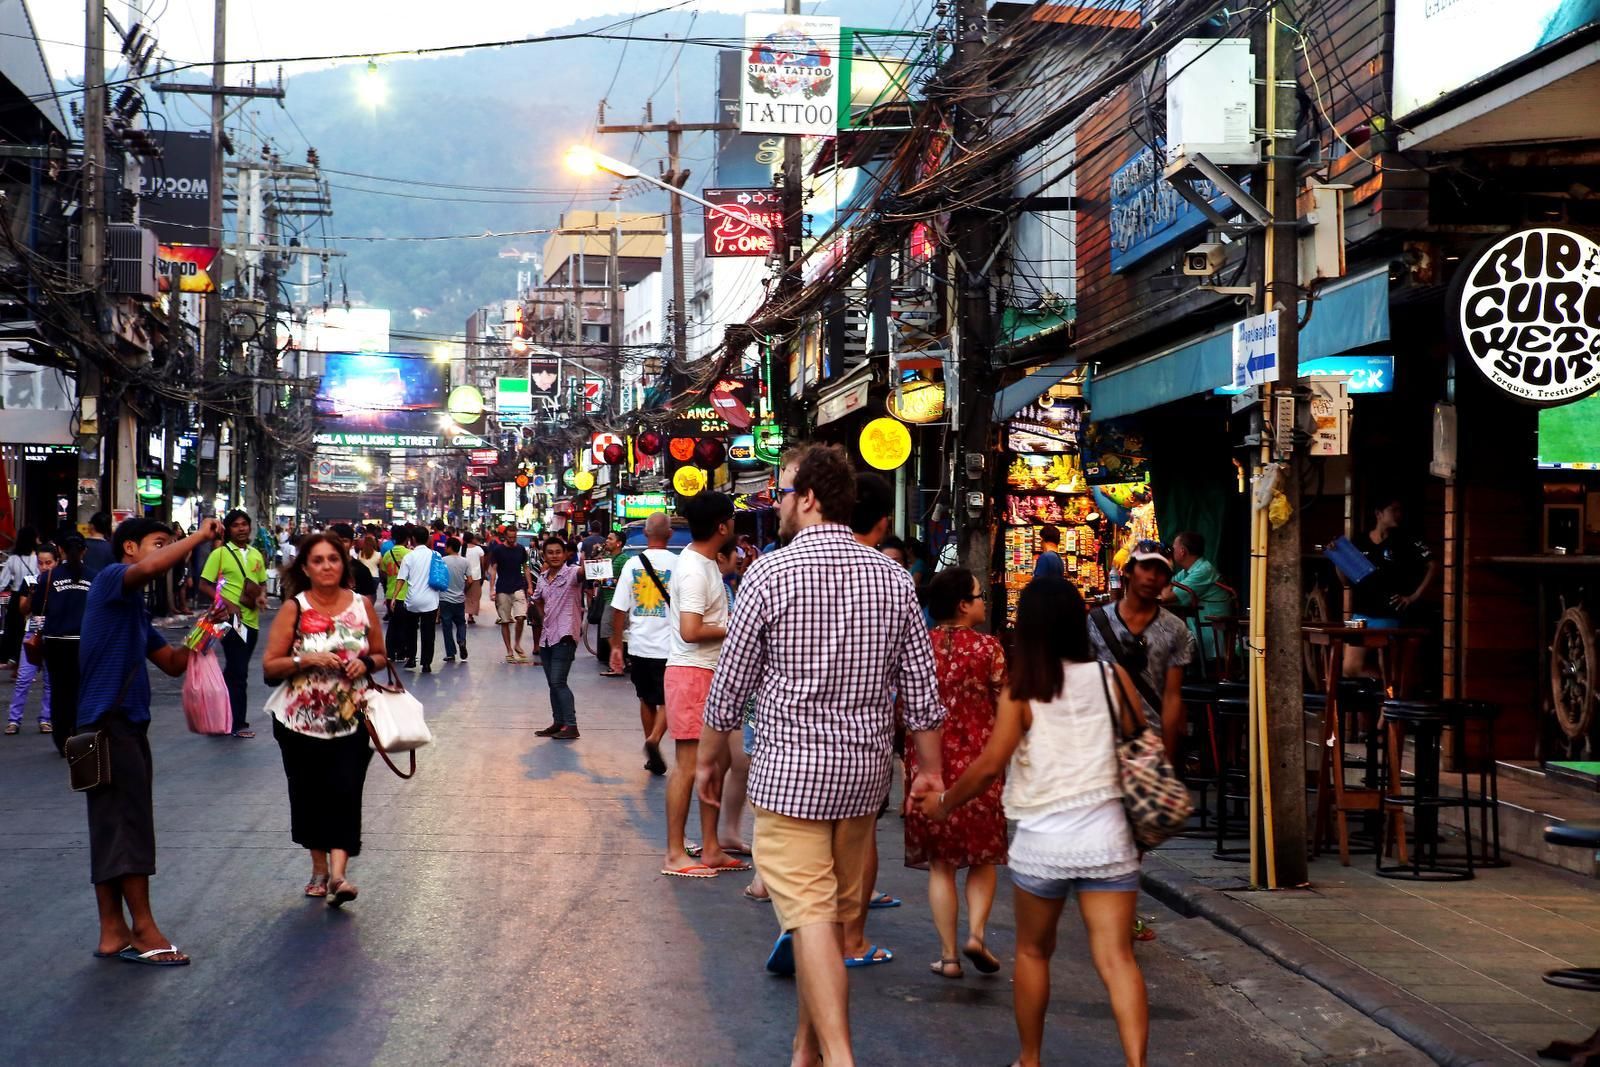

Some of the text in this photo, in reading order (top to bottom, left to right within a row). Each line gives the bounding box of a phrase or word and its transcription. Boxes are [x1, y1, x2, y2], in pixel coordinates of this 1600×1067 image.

[748, 64, 832, 76] SIAM TATTOO
[745, 102, 833, 125] TATTOO
[1472, 231, 1581, 288] RIP
[1491, 370, 1533, 397] Torquay,
[1538, 384, 1583, 398] Trestles,
[344, 434, 396, 445] WALKING
[398, 436, 438, 447] STREET
